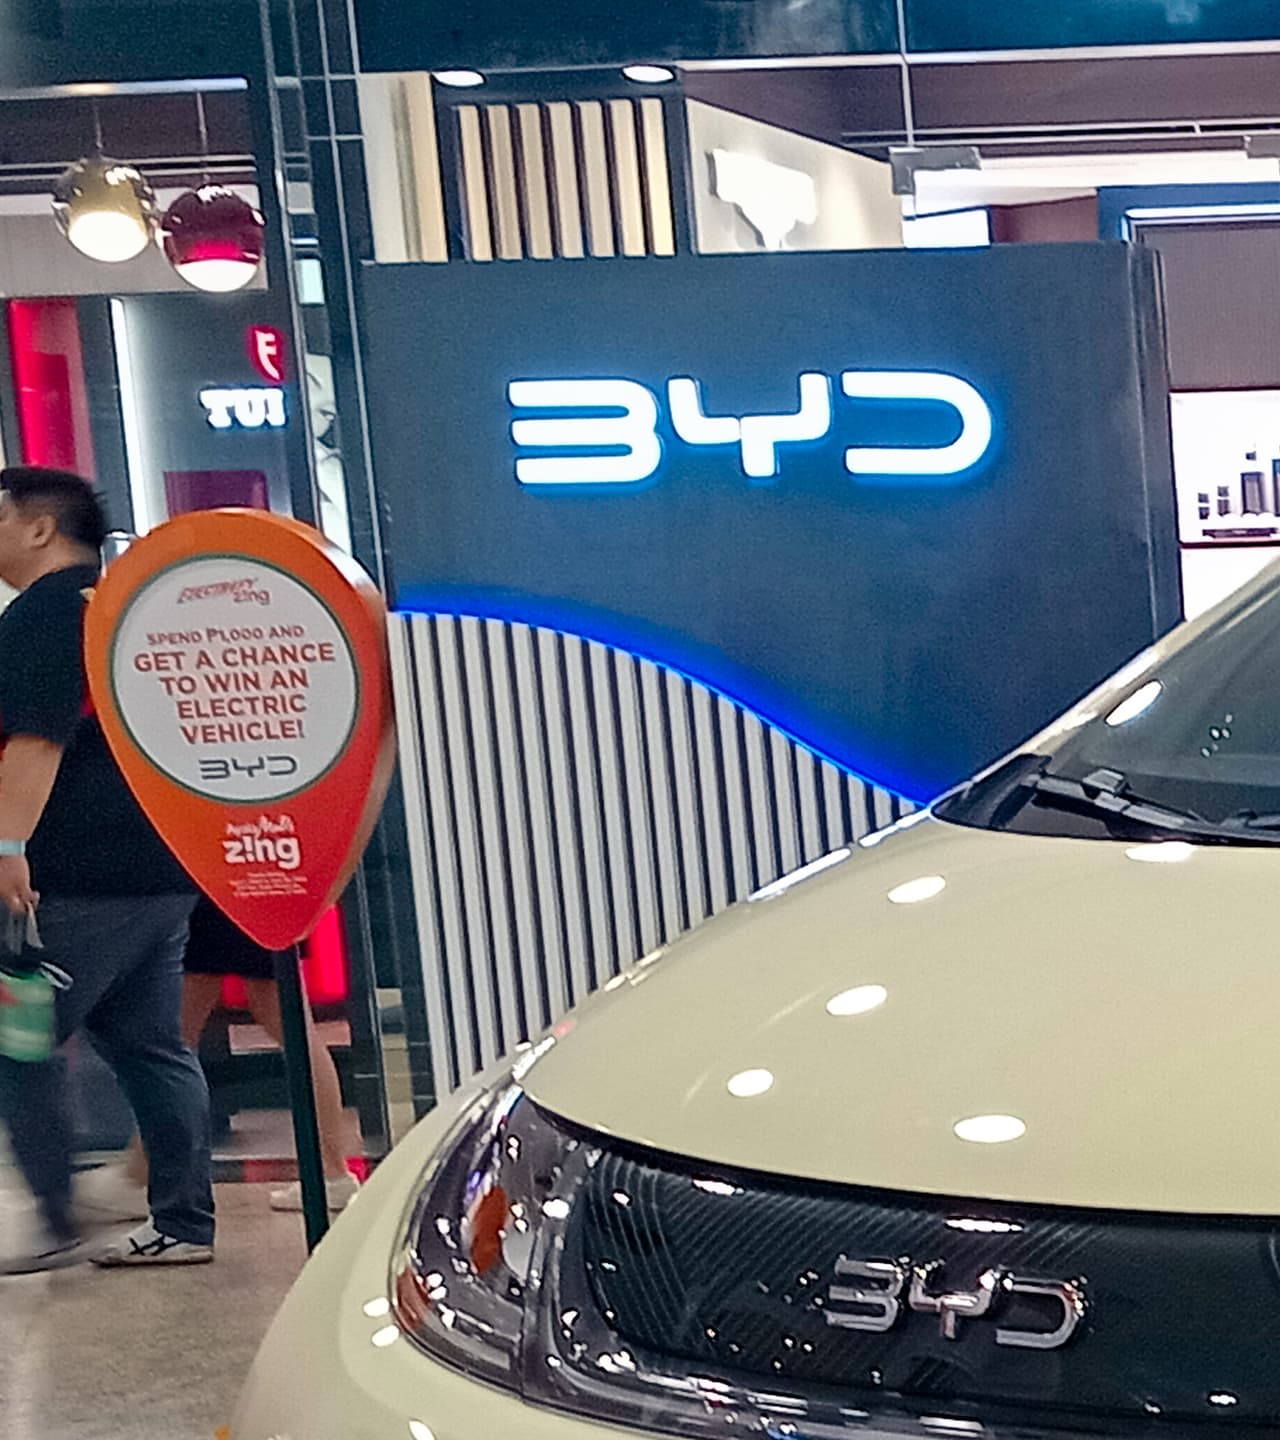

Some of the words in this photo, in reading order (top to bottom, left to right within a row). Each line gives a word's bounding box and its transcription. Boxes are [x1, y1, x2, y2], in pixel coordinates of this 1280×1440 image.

[508, 370, 992, 484] BYD
[147, 630, 202, 645] SPEND
[269, 625, 304, 638] AND
[134, 651, 186, 672] GET
[196, 652, 215, 670] A
[222, 643, 336, 667] CHANCE
[159, 676, 197, 697] TO
[205, 672, 261, 693] WIN
[270, 668, 310, 690] AN
[177, 694, 307, 719] ELECTRIC
[181, 720, 305, 745] VEHICLE!
[199, 756, 298, 780] BYD
[826, 1254, 1080, 1349] BYD
